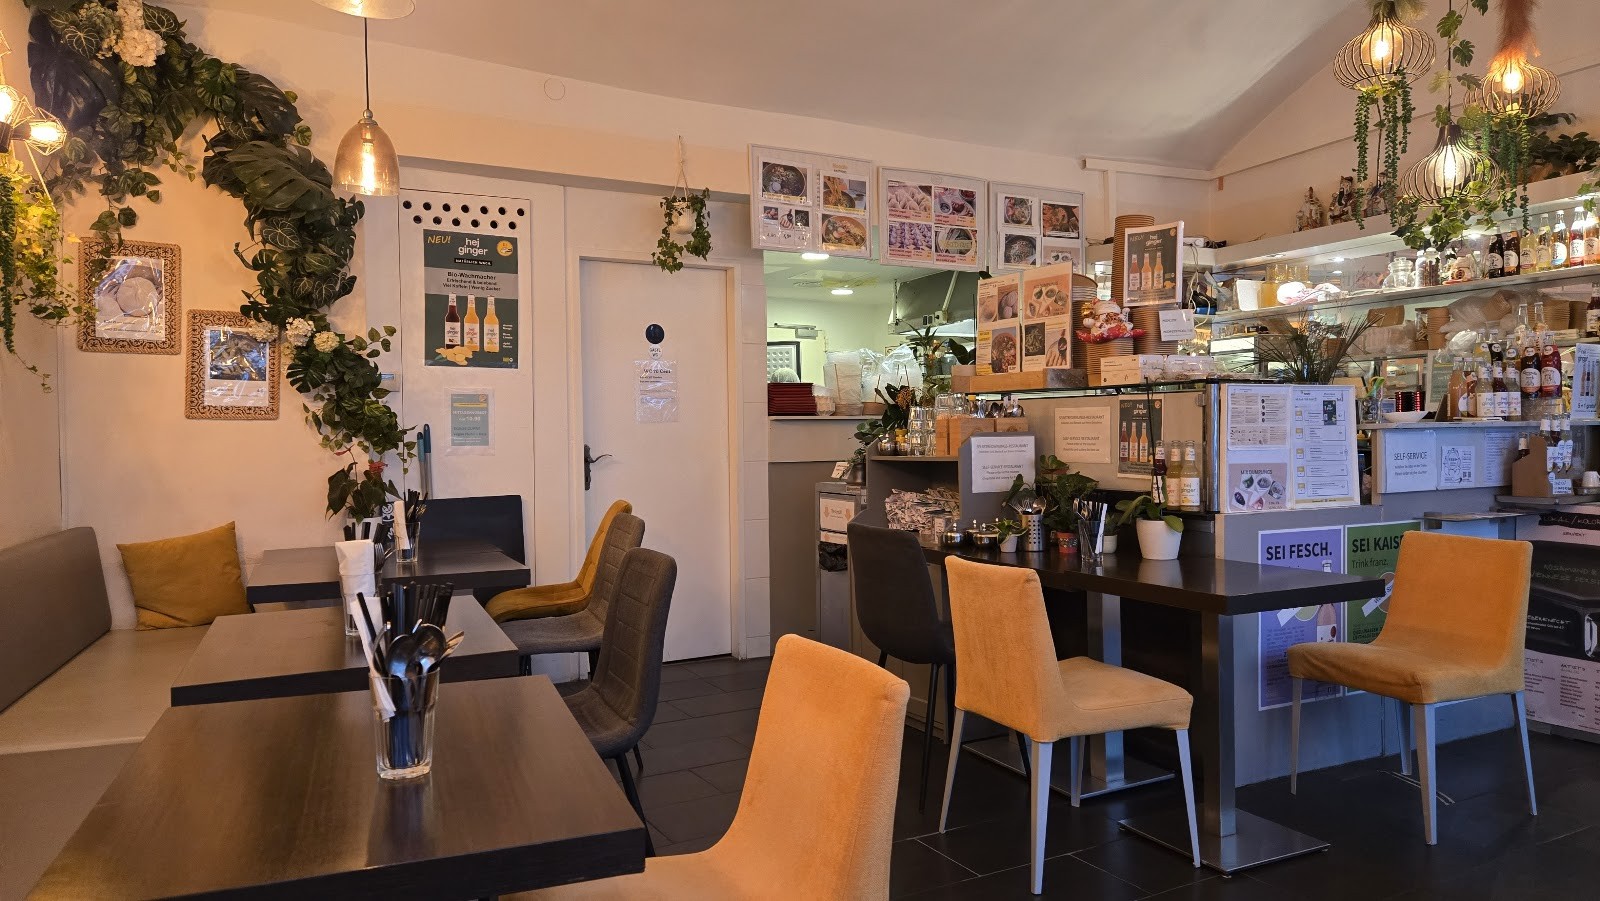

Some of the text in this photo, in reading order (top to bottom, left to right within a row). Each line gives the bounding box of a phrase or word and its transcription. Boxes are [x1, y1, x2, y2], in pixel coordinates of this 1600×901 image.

[428, 236, 451, 244] NEU!
[465, 238, 480, 247] hej
[458, 245, 488, 256] ginger
[447, 271, 496, 280] Bio-Wachmacher
[1394, 452, 1427, 460] SELF-SERVICE
[1352, 538, 1369, 553] SEI
[1266, 542, 1332, 560] SEI FESCH.
[1352, 558, 1388, 568] Trink franz.
